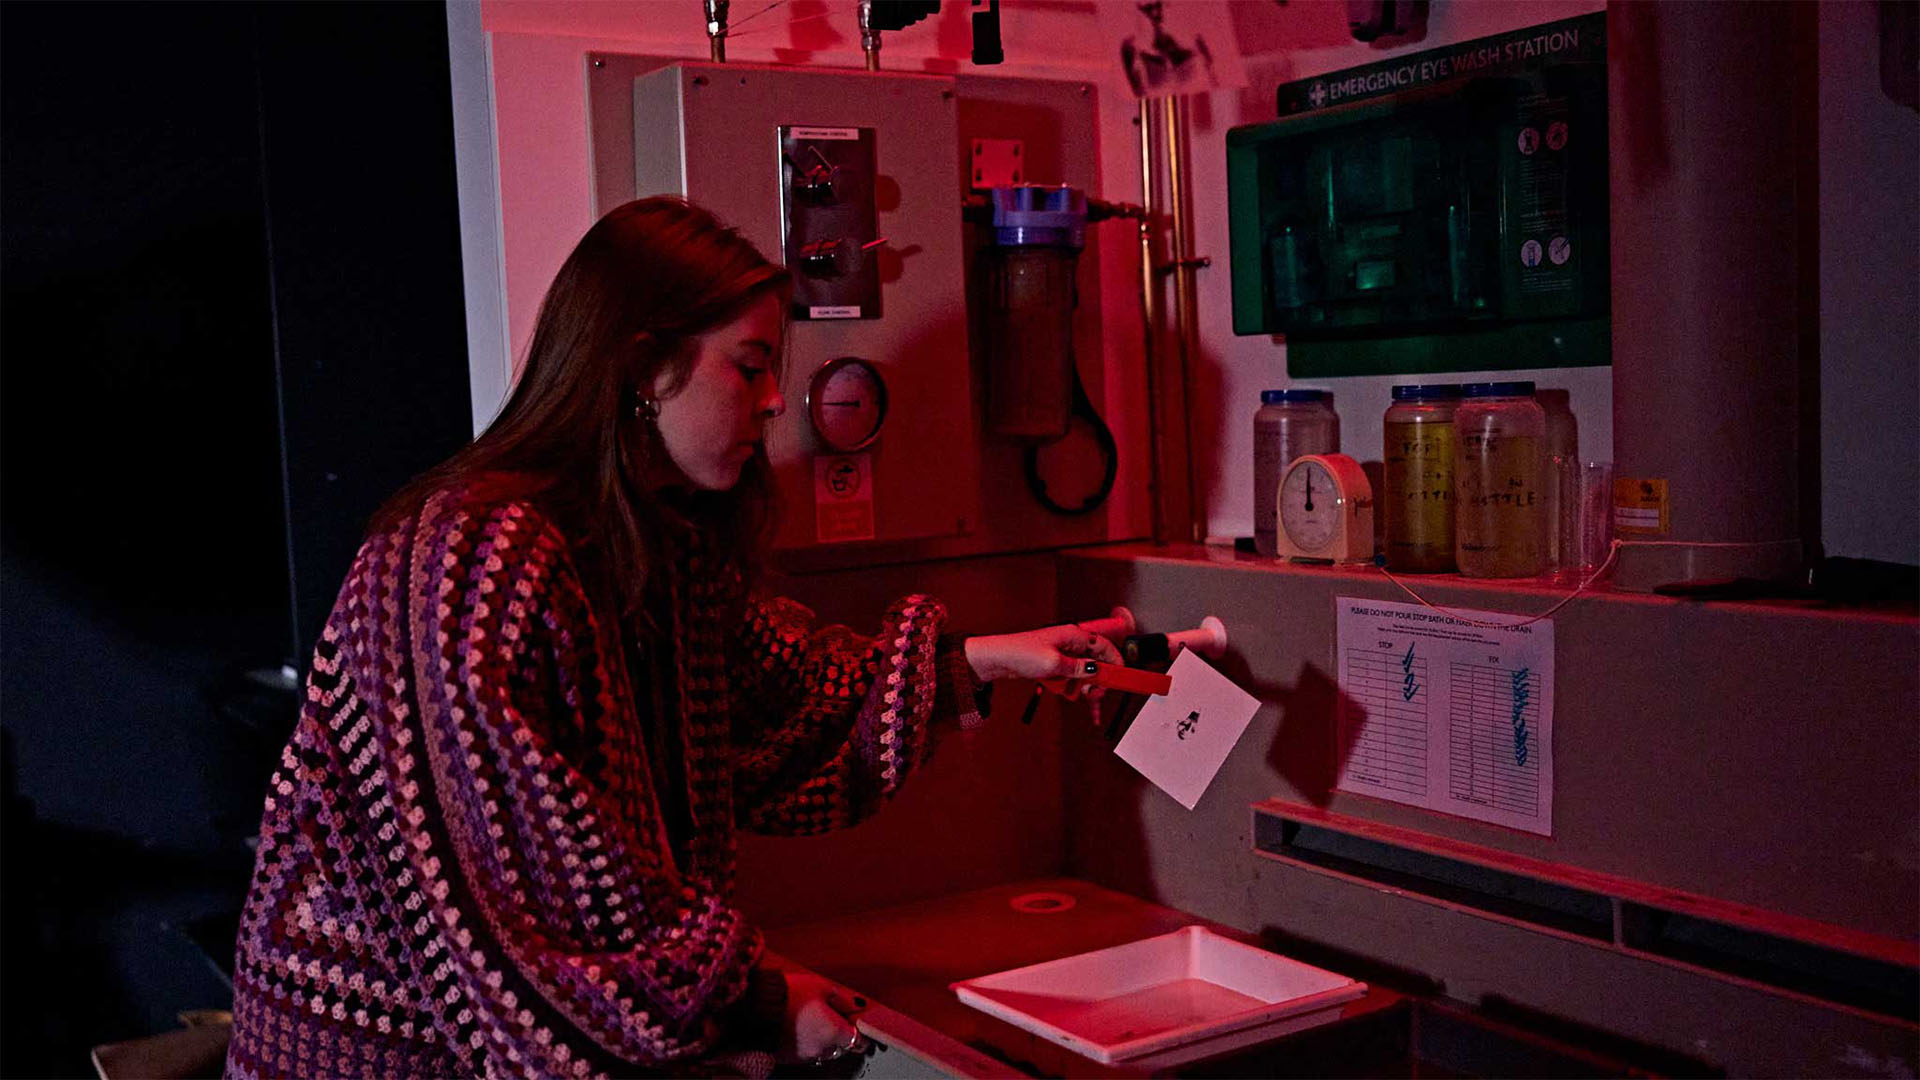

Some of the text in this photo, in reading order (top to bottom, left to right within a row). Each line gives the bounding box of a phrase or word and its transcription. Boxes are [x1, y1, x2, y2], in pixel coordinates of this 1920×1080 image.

[1330, 29, 1579, 100] EMERGENCY EYE WASH STATION
[1351, 607, 1369, 615] PLEASE
[1381, 610, 1394, 618] NOT
[1395, 611, 1411, 619] POUR
[1413, 613, 1428, 622] STOP
[1428, 615, 1444, 624] BATH
[1445, 617, 1456, 625] OR
[1510, 624, 1532, 633] DRAIN
[1378, 641, 1393, 649] STOP
[1488, 656, 1500, 664] FIX
